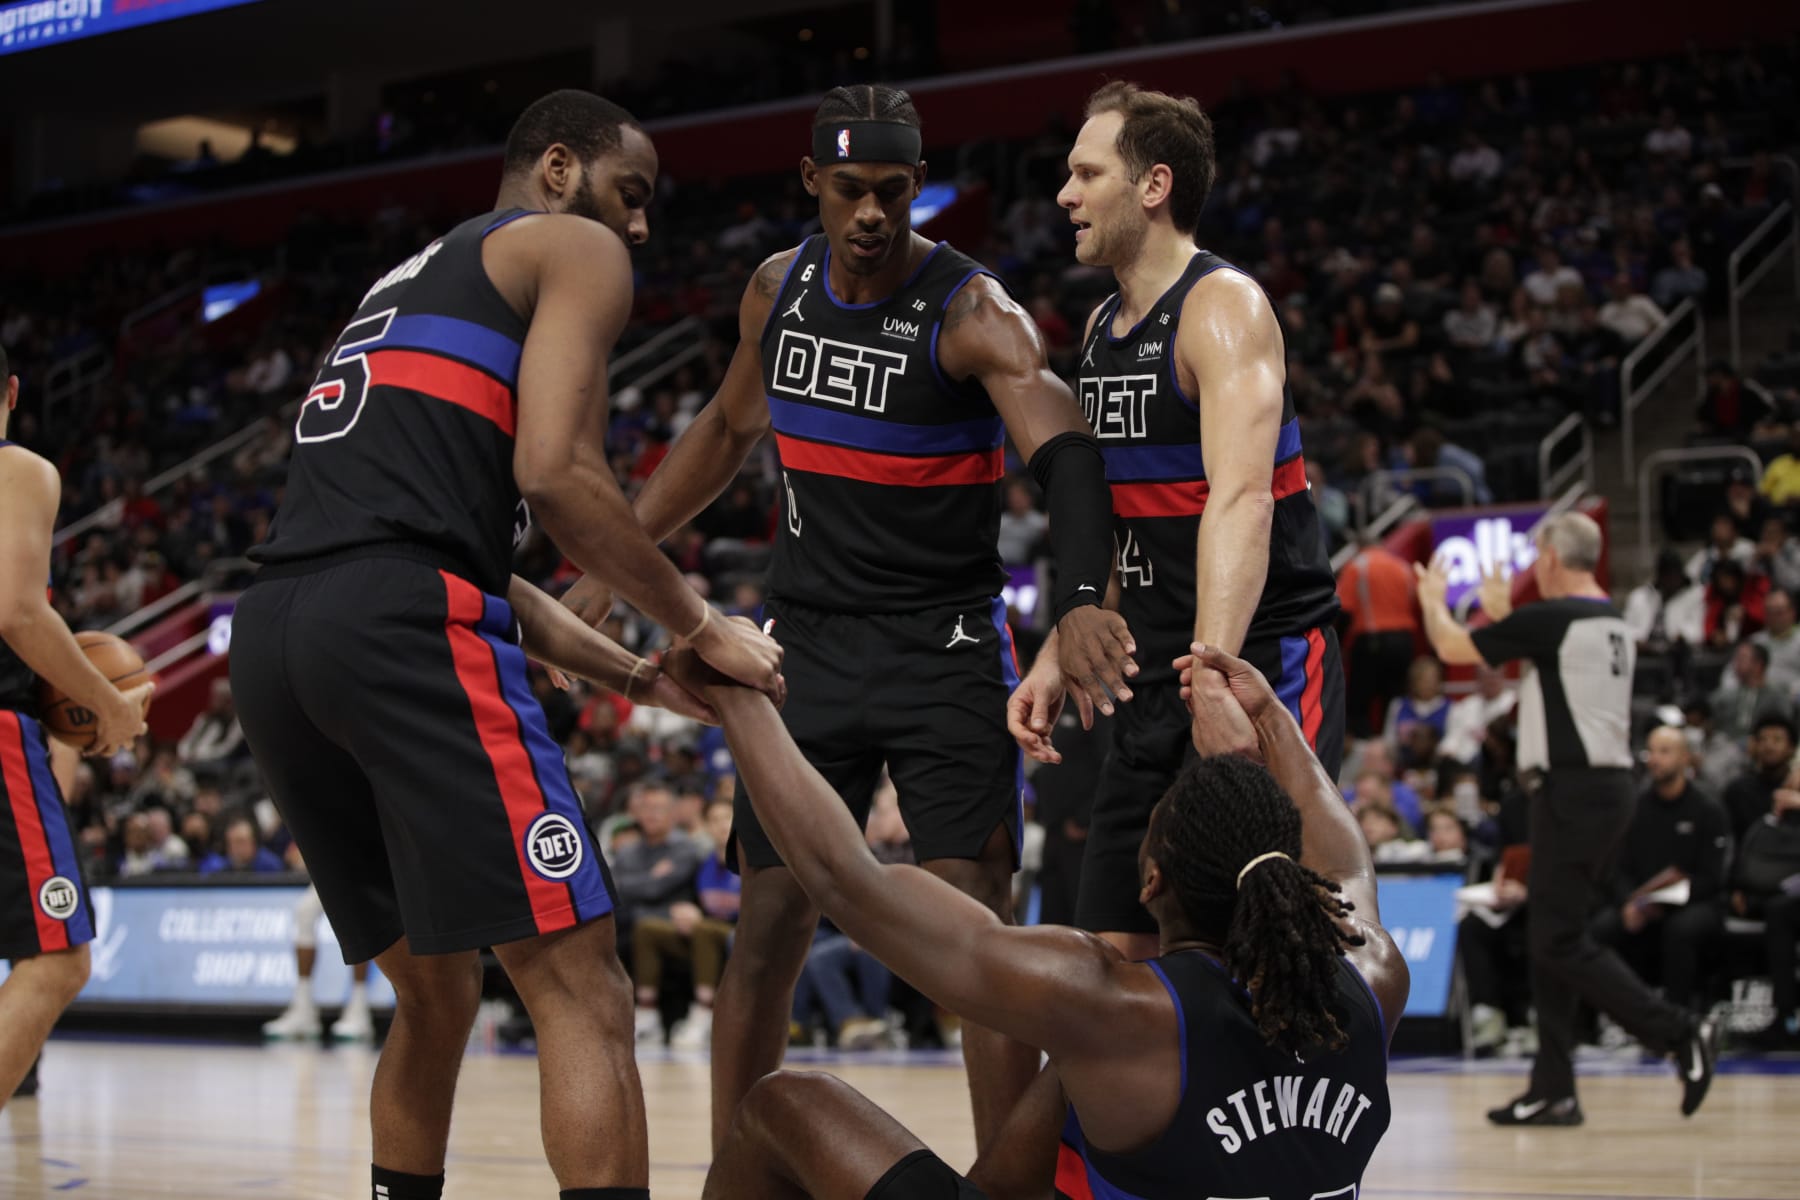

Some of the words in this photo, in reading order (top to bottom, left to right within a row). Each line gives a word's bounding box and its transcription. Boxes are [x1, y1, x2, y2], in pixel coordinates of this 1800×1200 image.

[801, 264, 815, 282] 6
[912, 298, 927, 312] 16
[882, 316, 920, 337] UWM
[1158, 312, 1171, 325] 16
[1138, 340, 1163, 357] UWM
[772, 329, 908, 413] DET
[1079, 374, 1157, 439] DET
[536, 831, 574, 861] DET
[47, 887, 73, 908] DET
[159, 907, 291, 943] COLLECTION
[193, 952, 254, 986] SHOP
[1205, 1075, 1373, 1155] STEWART
